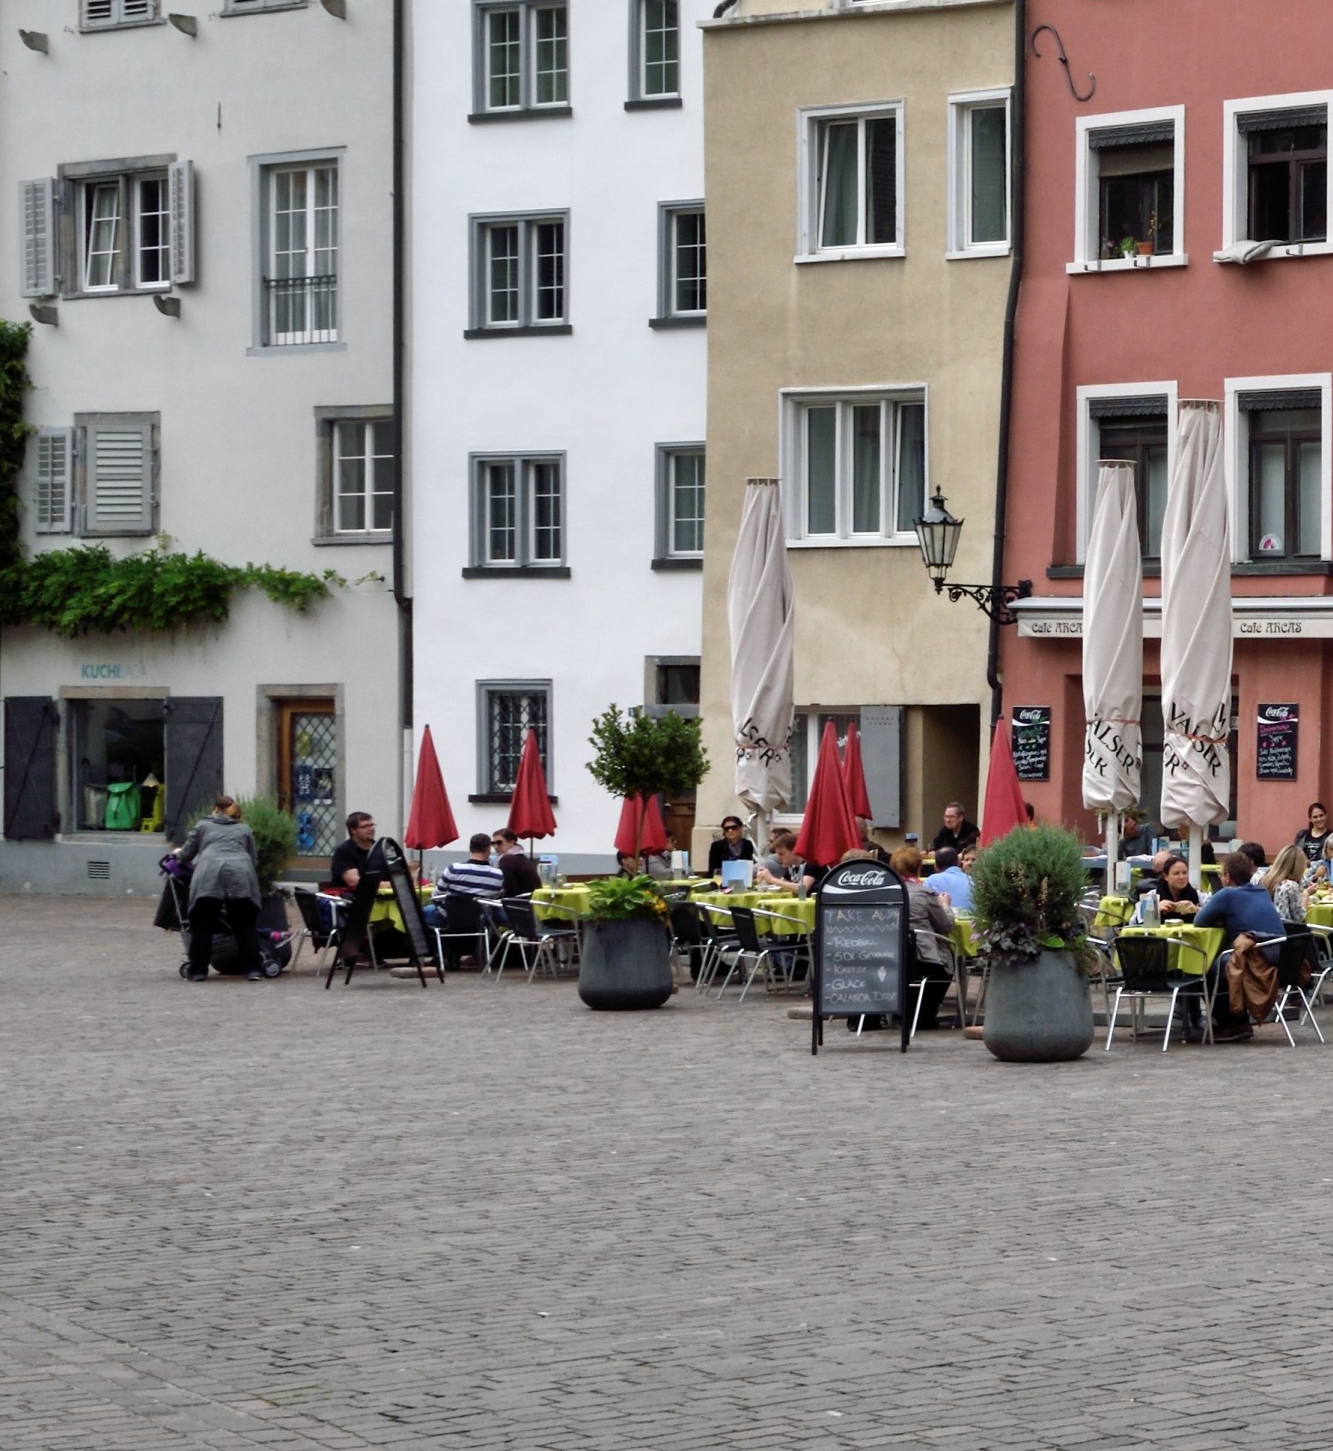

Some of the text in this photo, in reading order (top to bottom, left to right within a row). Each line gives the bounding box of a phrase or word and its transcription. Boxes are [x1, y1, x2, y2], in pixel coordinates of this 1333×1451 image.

[1031, 622, 1083, 634] Café ARCA
[1240, 622, 1302, 634] Café ARCAS
[1091, 714, 1135, 776] ALSER
[824, 909, 863, 922] TAKE
